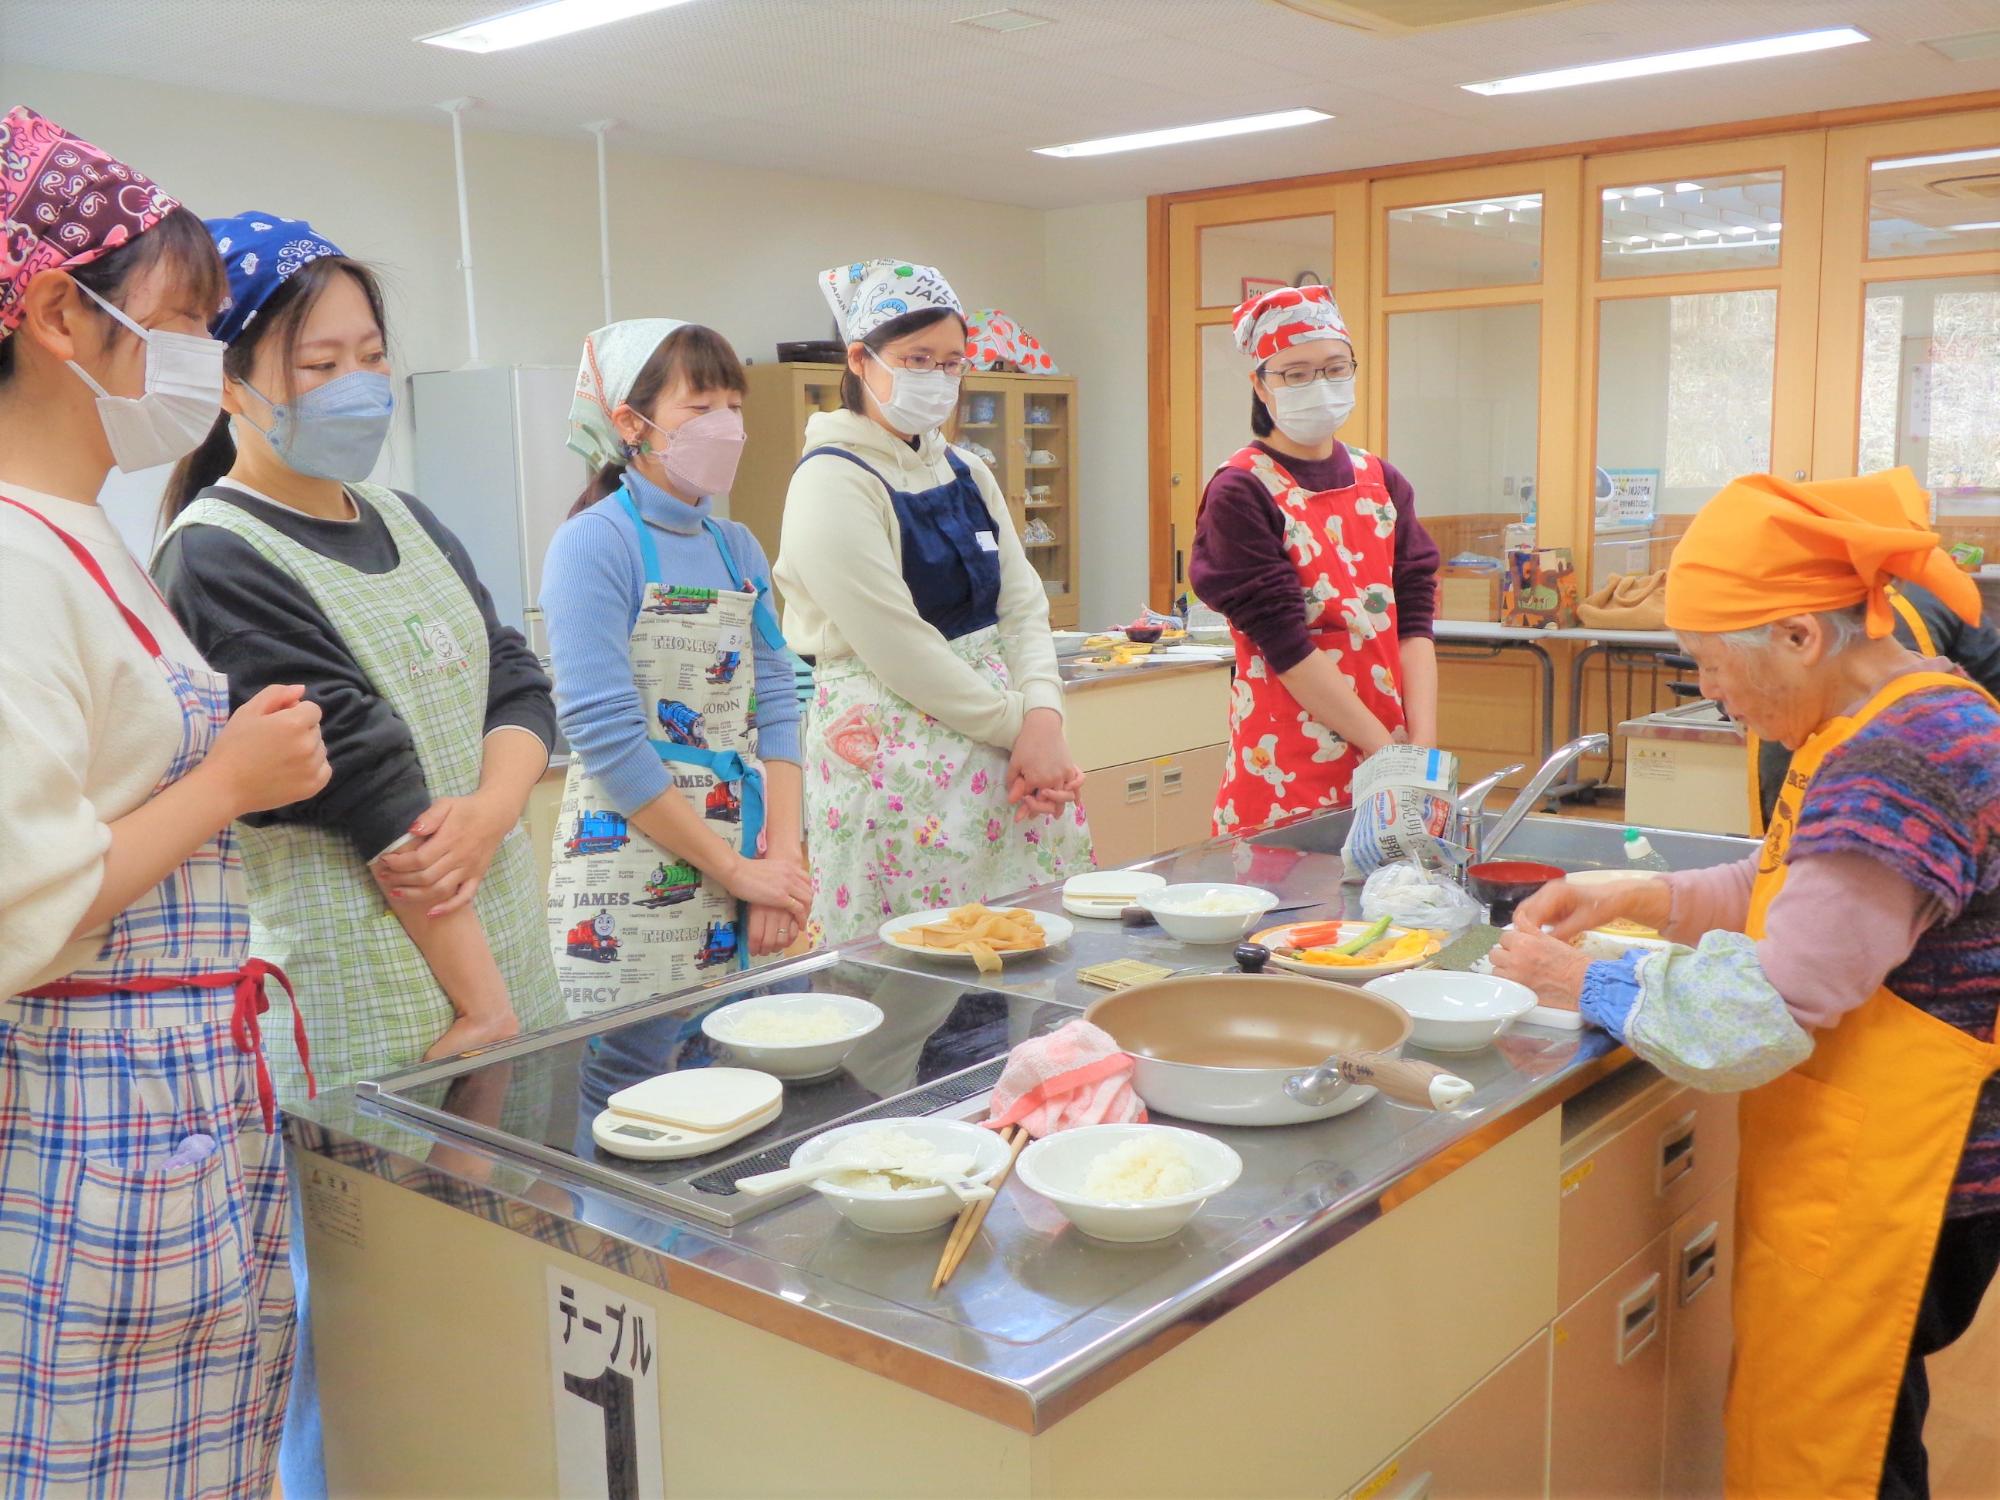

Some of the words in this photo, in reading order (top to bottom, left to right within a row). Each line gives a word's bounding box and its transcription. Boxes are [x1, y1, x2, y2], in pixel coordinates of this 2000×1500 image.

[652, 635, 717, 655] THOMAS
[573, 892, 631, 909] JAMES
[641, 926, 700, 944] THOMAS
[562, 987, 621, 1004] PERCY
[559, 1284, 652, 1377] テーブル
[563, 1365, 640, 1500] 1
